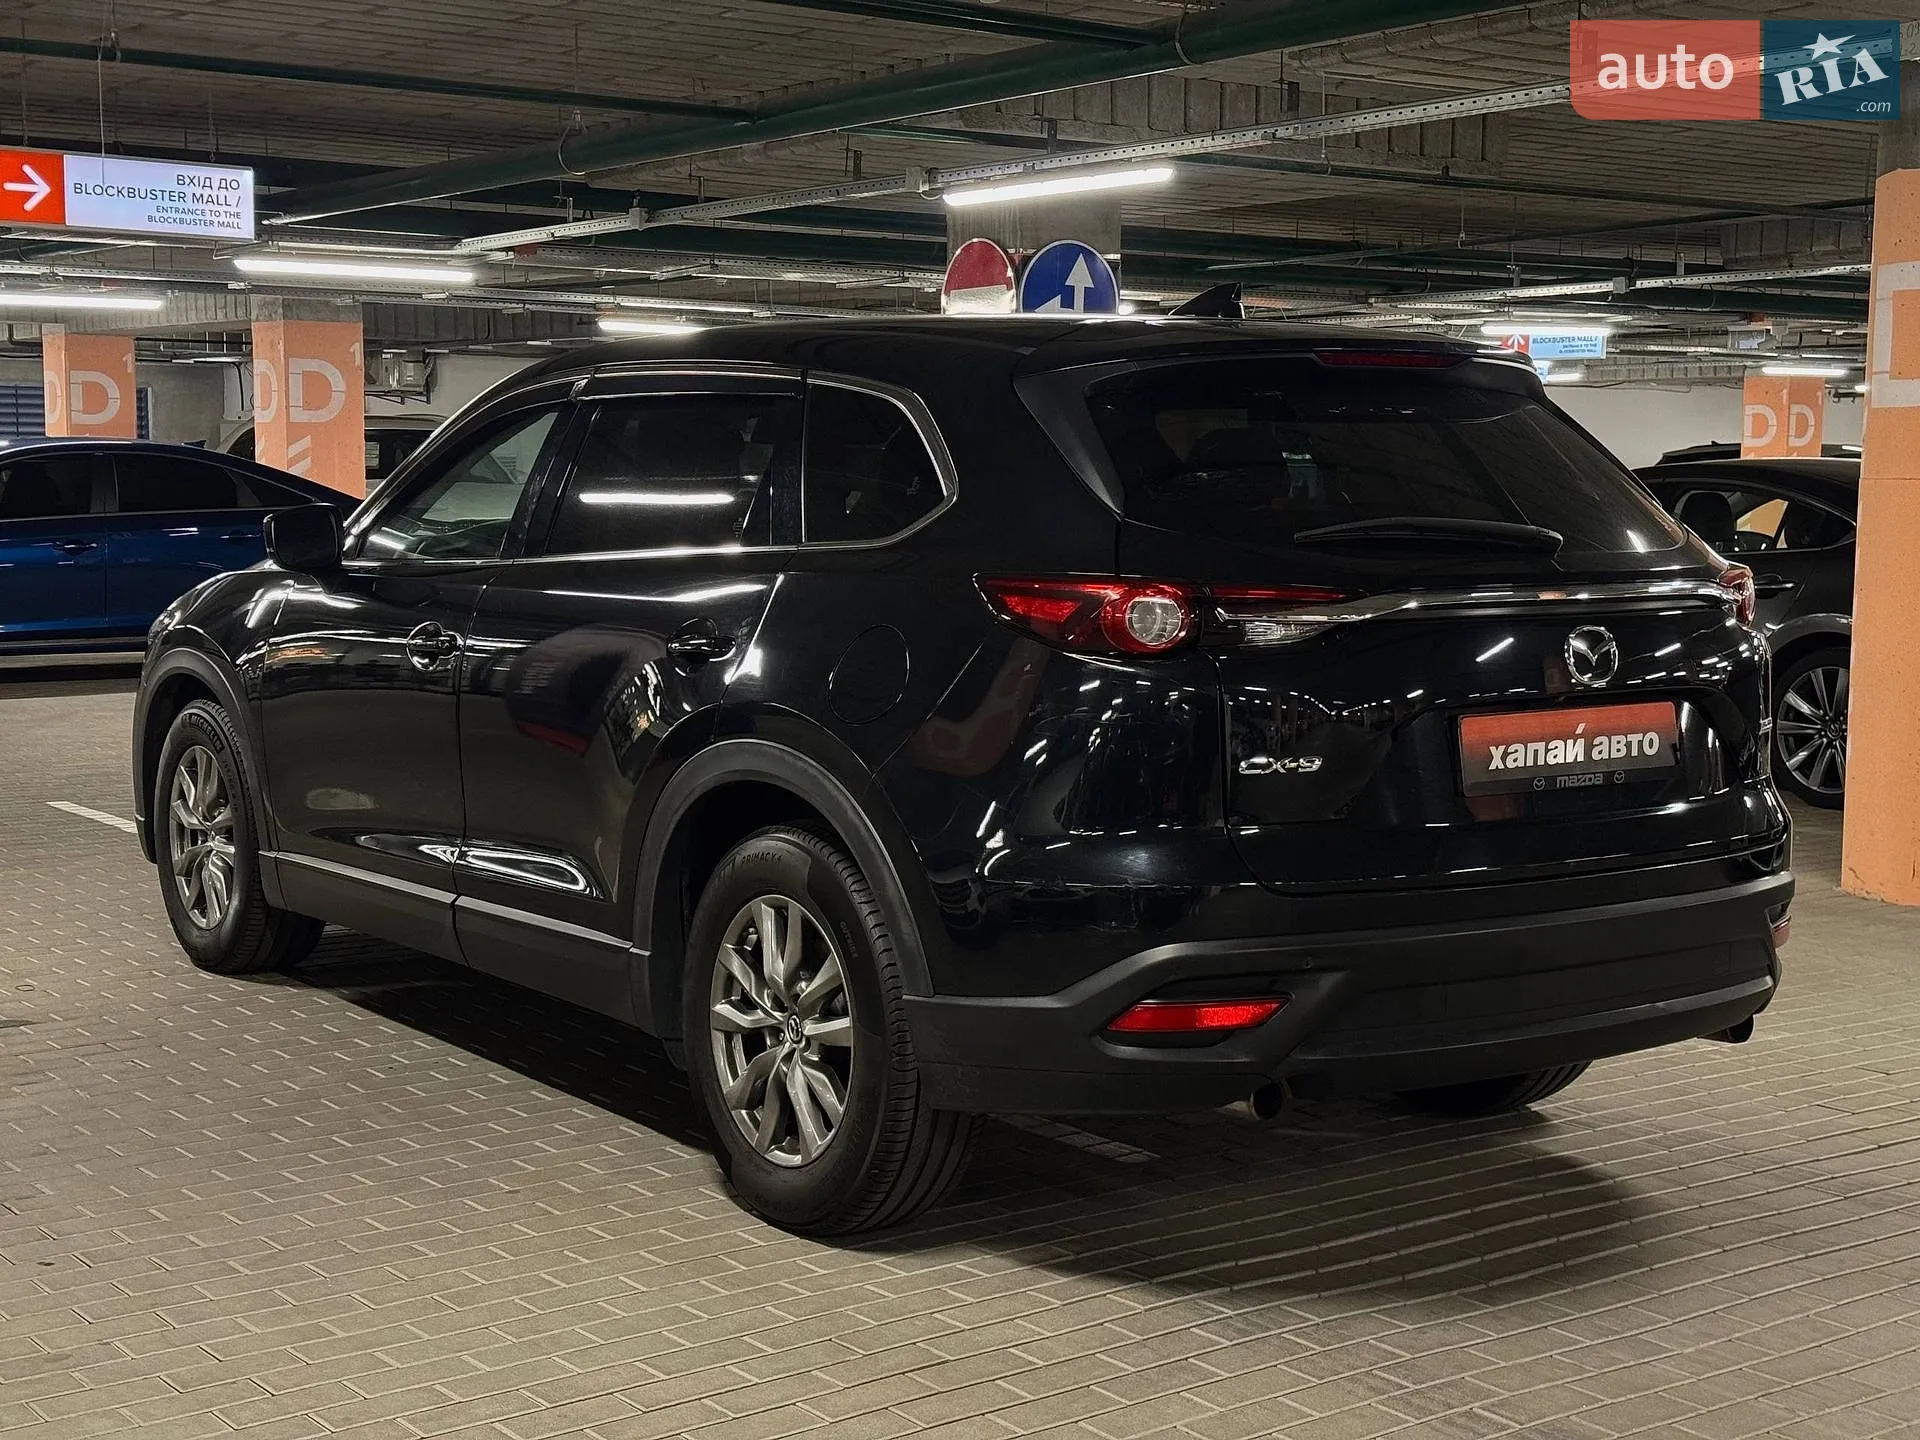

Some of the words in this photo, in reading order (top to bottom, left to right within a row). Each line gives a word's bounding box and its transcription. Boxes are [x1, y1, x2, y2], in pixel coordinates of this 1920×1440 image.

[73, 182, 187, 204] BLOCKBUSTER
[191, 193, 232, 207] MALL
[176, 174, 213, 190] ВХІД
[217, 178, 241, 191] ДО
[147, 215, 215, 227] BLOCKBUSTER
[217, 220, 242, 230] MALL
[156, 205, 206, 217] ENTRANCE
[208, 209, 221, 218] TO
[224, 210, 241, 219] THE
[1532, 336, 1576, 344] BLOCKBUSTER
[70, 370, 120, 424] D
[289, 358, 345, 422] D
[1744, 404, 1777, 447] D
[1789, 404, 1815, 447] D
[1591, 731, 1660, 759] авто
[1239, 755, 1323, 775] CX-9
